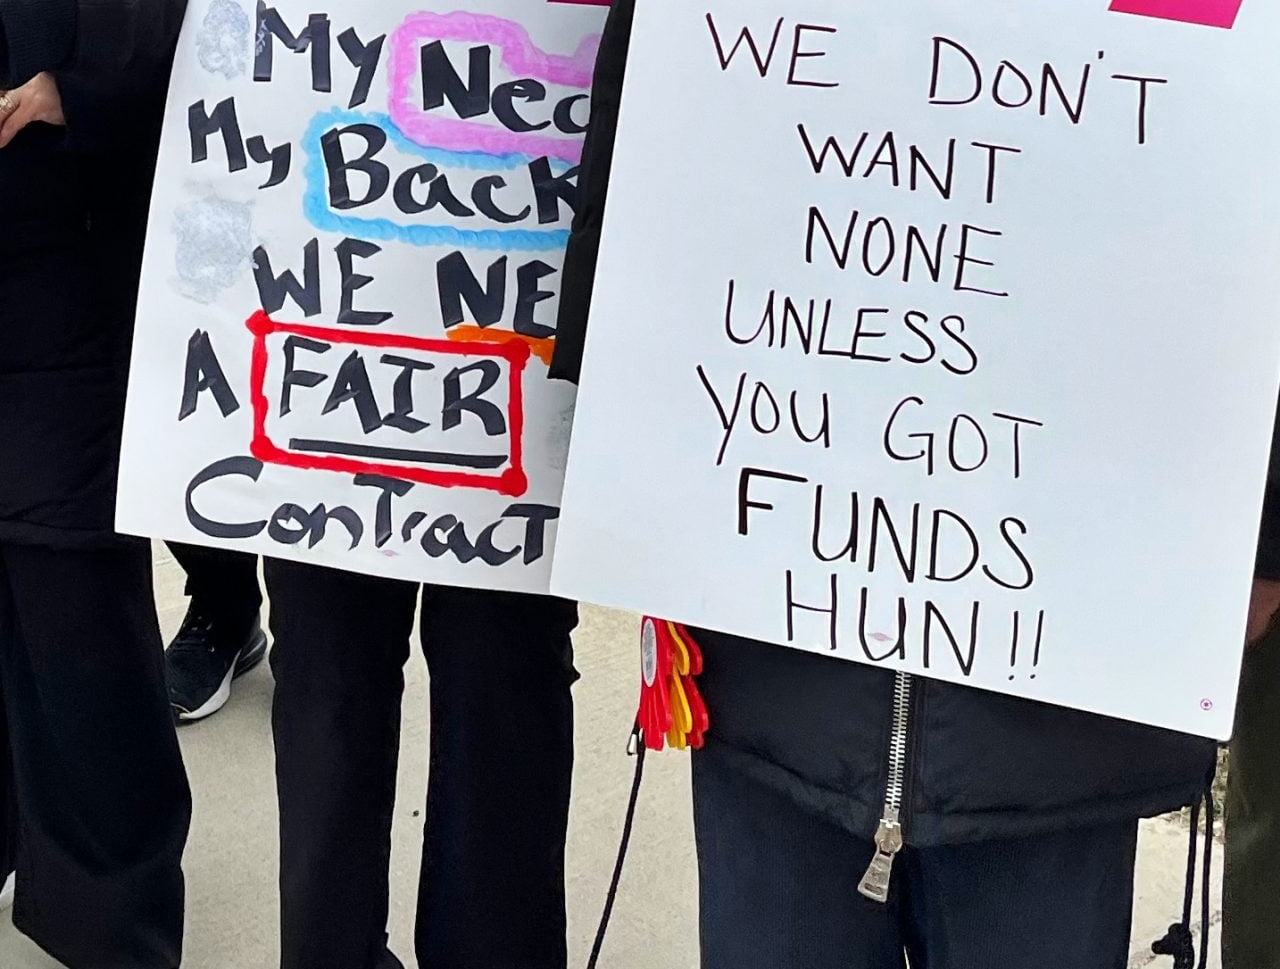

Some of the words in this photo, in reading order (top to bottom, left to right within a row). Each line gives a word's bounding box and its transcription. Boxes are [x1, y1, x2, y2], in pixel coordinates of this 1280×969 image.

[253, 0, 387, 110] My
[420, 39, 591, 134] Nec
[706, 13, 839, 88] WE
[928, 36, 1168, 145] DON'T
[187, 96, 292, 190] My
[320, 121, 579, 222] Back
[798, 123, 1021, 205] WANT
[252, 237, 394, 326] WE
[436, 249, 556, 338] NE
[805, 206, 1009, 297] NONE
[178, 328, 241, 422] A
[278, 335, 509, 436] FAIR
[723, 279, 979, 376] UNLESS
[696, 365, 832, 466] YOU
[883, 396, 1044, 479] GOT
[737, 467, 1035, 591] FUNDS
